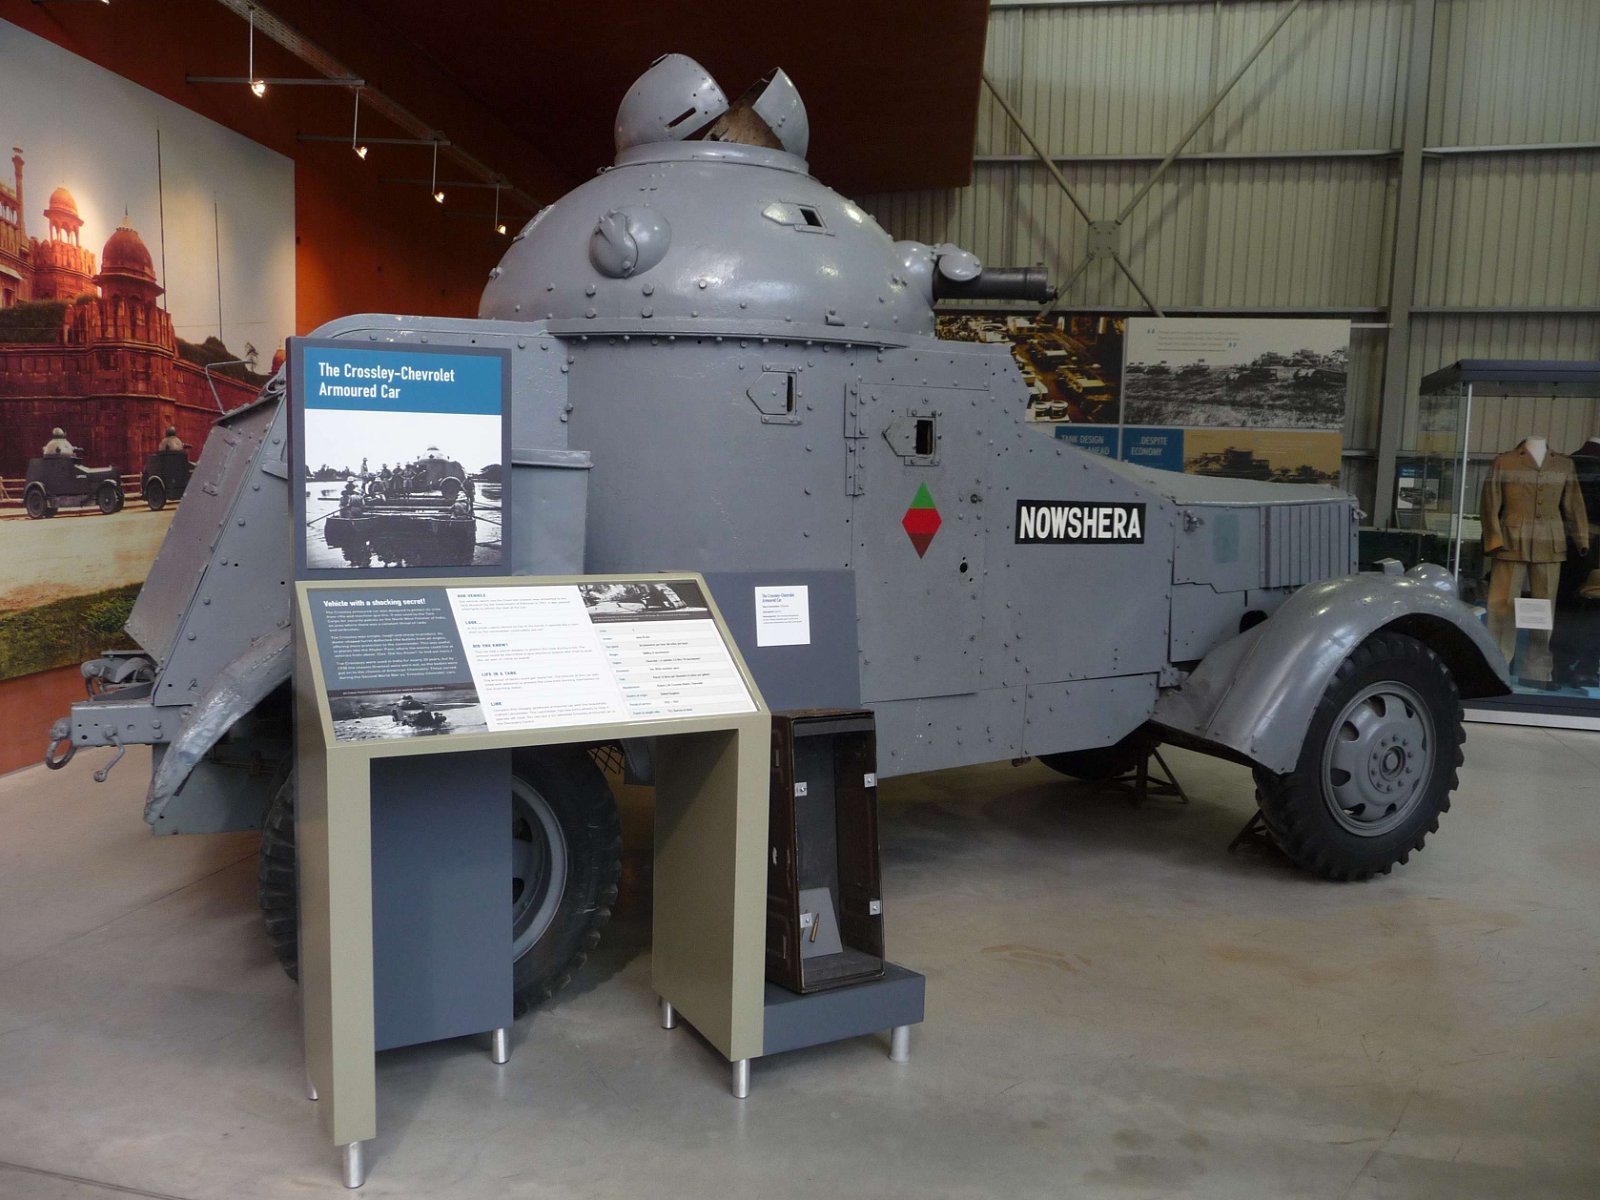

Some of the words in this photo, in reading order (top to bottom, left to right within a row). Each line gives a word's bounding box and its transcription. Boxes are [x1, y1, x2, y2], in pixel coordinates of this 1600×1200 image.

[318, 362, 340, 377] The
[344, 363, 455, 383] Crossley-Chevrolet
[318, 382, 377, 398] Armoured
[380, 384, 401, 399] Car
[1080, 435, 1104, 444] DESIGN
[1131, 447, 1163, 456] ECONOMY
[1019, 506, 1141, 539] NOWSHERA
[349, 599, 365, 607] with
[371, 598, 402, 607] shocking
